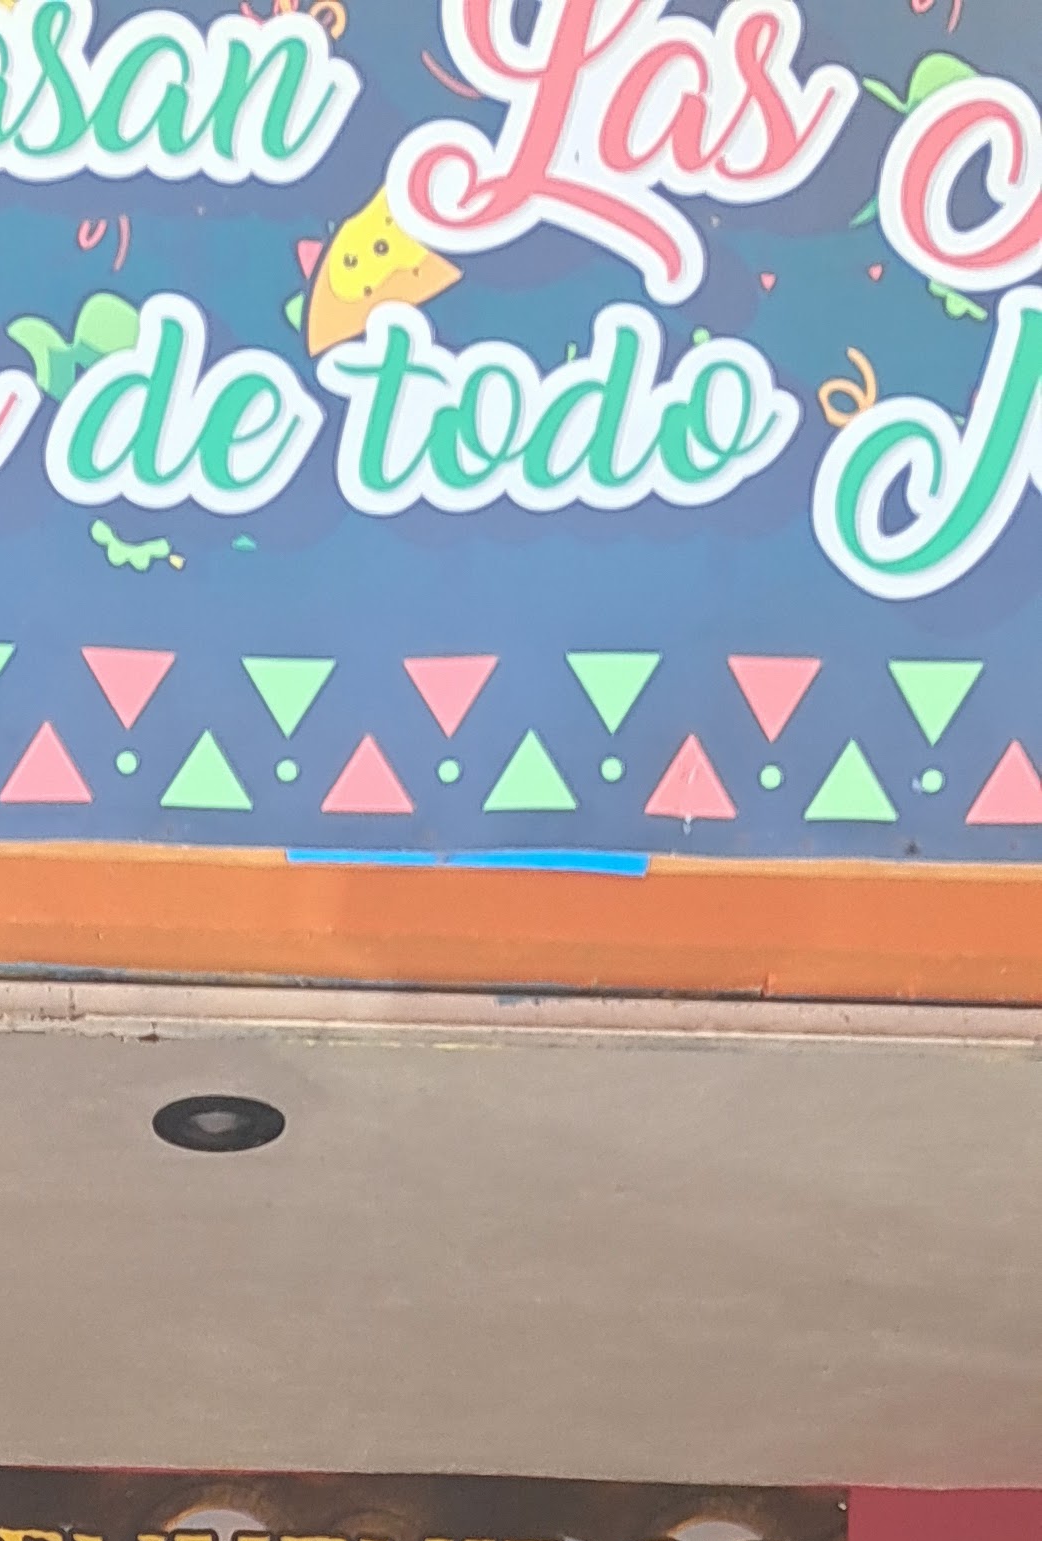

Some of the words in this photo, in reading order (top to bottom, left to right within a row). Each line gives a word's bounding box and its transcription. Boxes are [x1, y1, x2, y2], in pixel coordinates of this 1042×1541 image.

[408, 0, 836, 284] Las
[67, 319, 301, 490] de
[332, 326, 780, 493] todo
